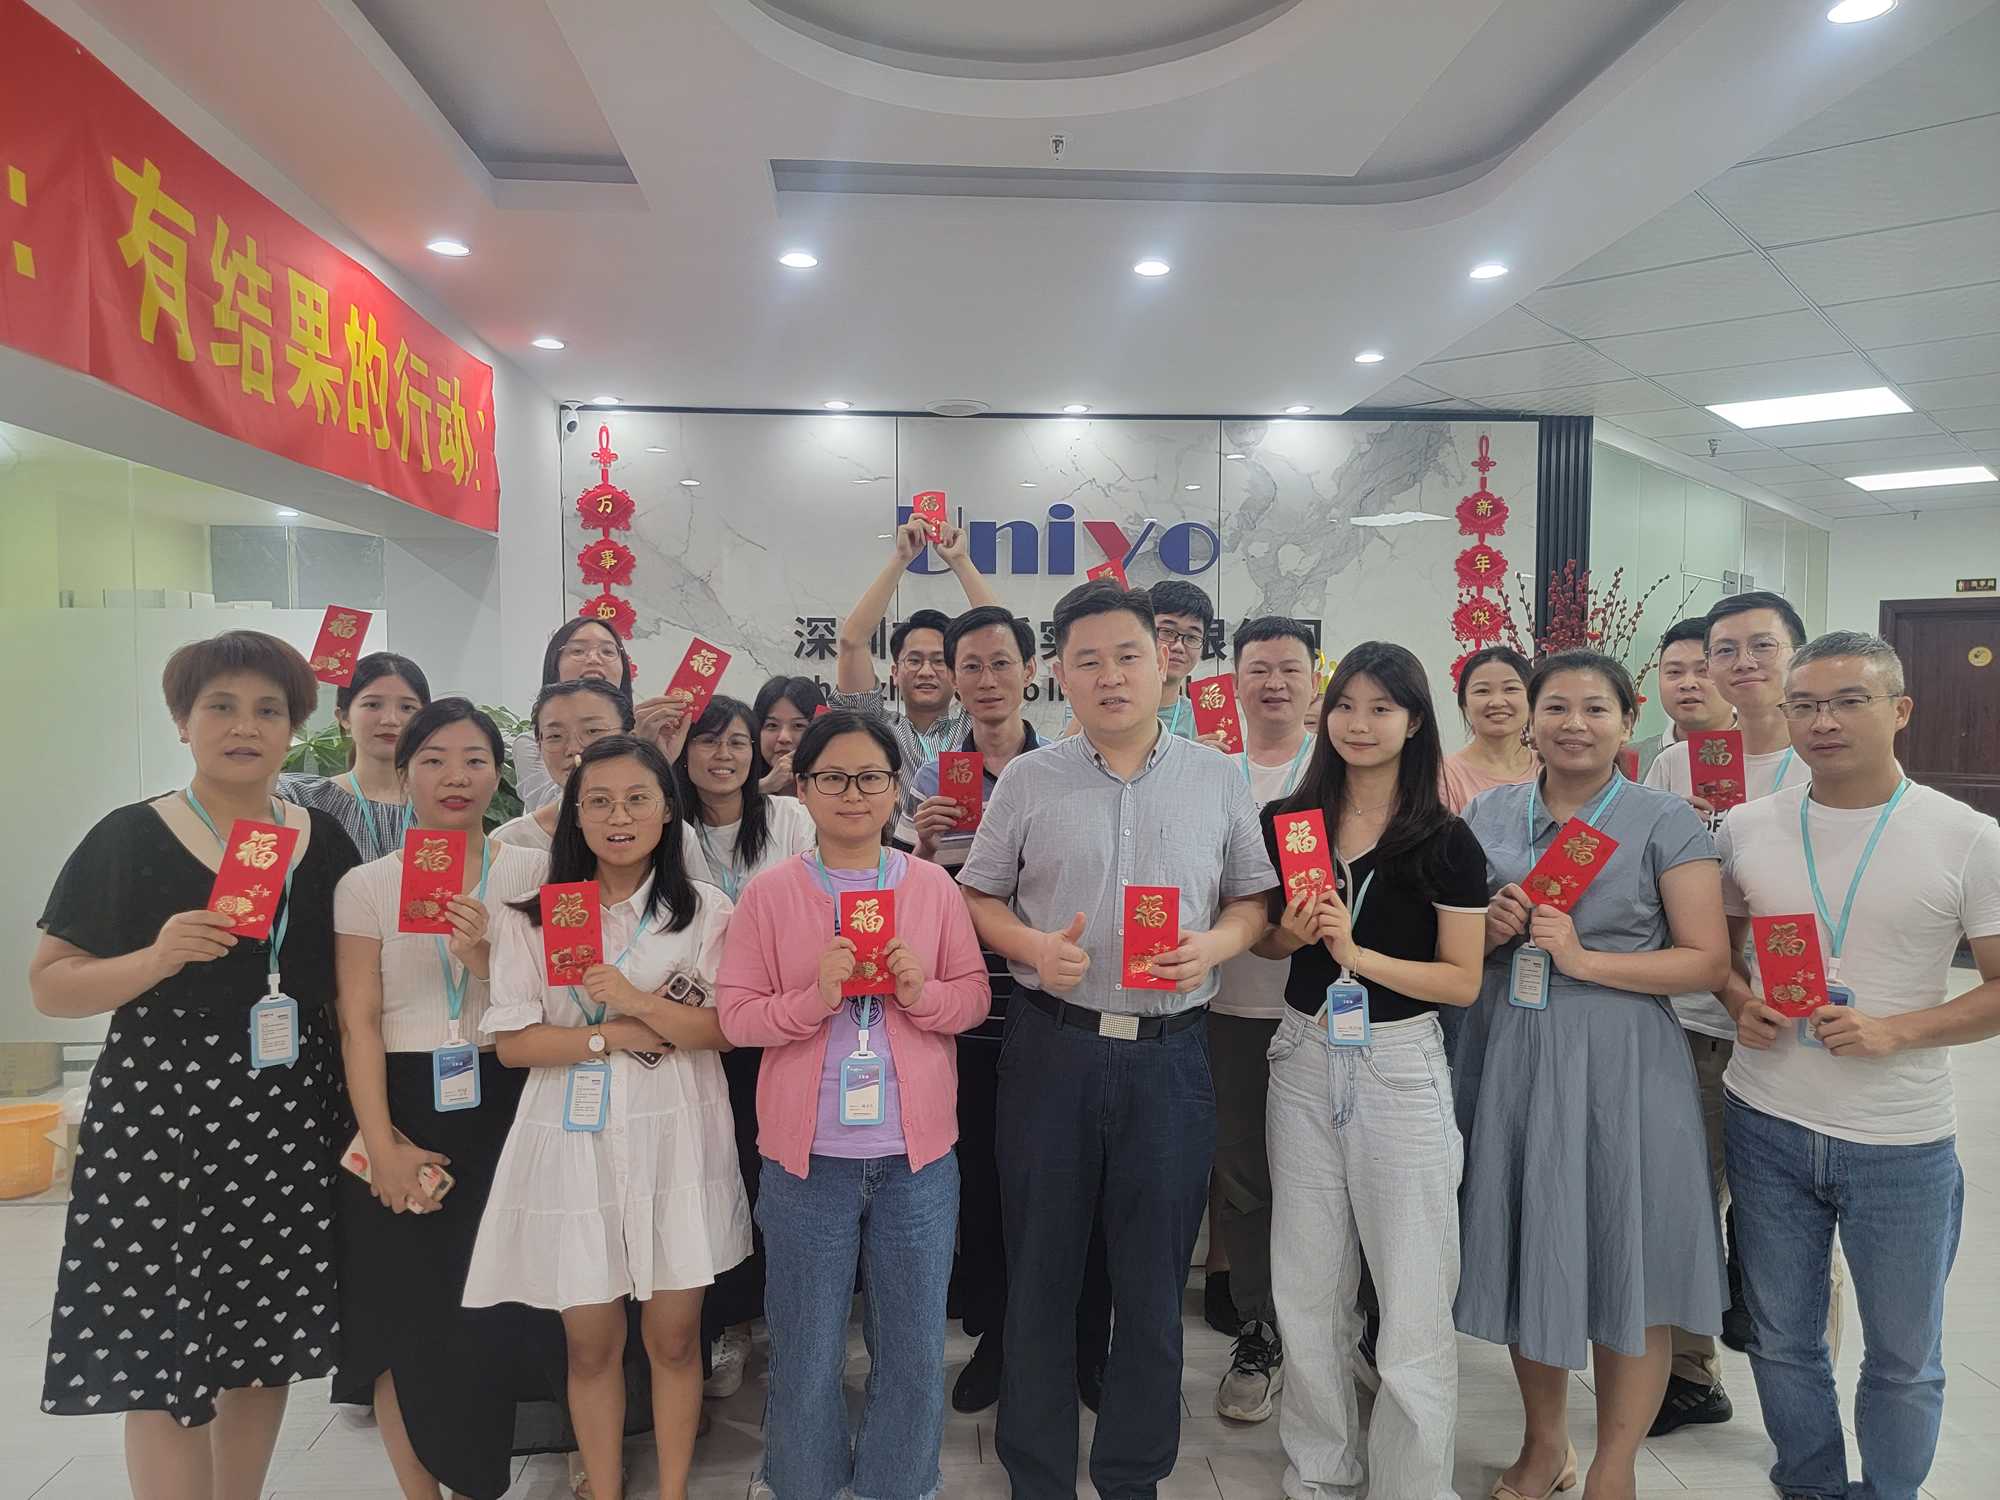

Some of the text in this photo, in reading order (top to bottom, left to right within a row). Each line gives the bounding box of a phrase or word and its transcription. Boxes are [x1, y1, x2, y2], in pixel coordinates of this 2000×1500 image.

[920, 495, 940, 512] 福
[328, 613, 357, 638] 福
[690, 649, 717, 677] 福
[1199, 683, 1226, 710] 福
[1698, 739, 1732, 765] 福
[947, 758, 974, 785] 福
[236, 831, 279, 870] 福
[1285, 820, 1317, 853] 福
[1563, 831, 1600, 866] 福
[414, 838, 452, 873] 福
[552, 892, 589, 927] 福
[850, 898, 884, 933] 福
[1134, 895, 1168, 929] 福
[1766, 922, 1806, 957] 福
